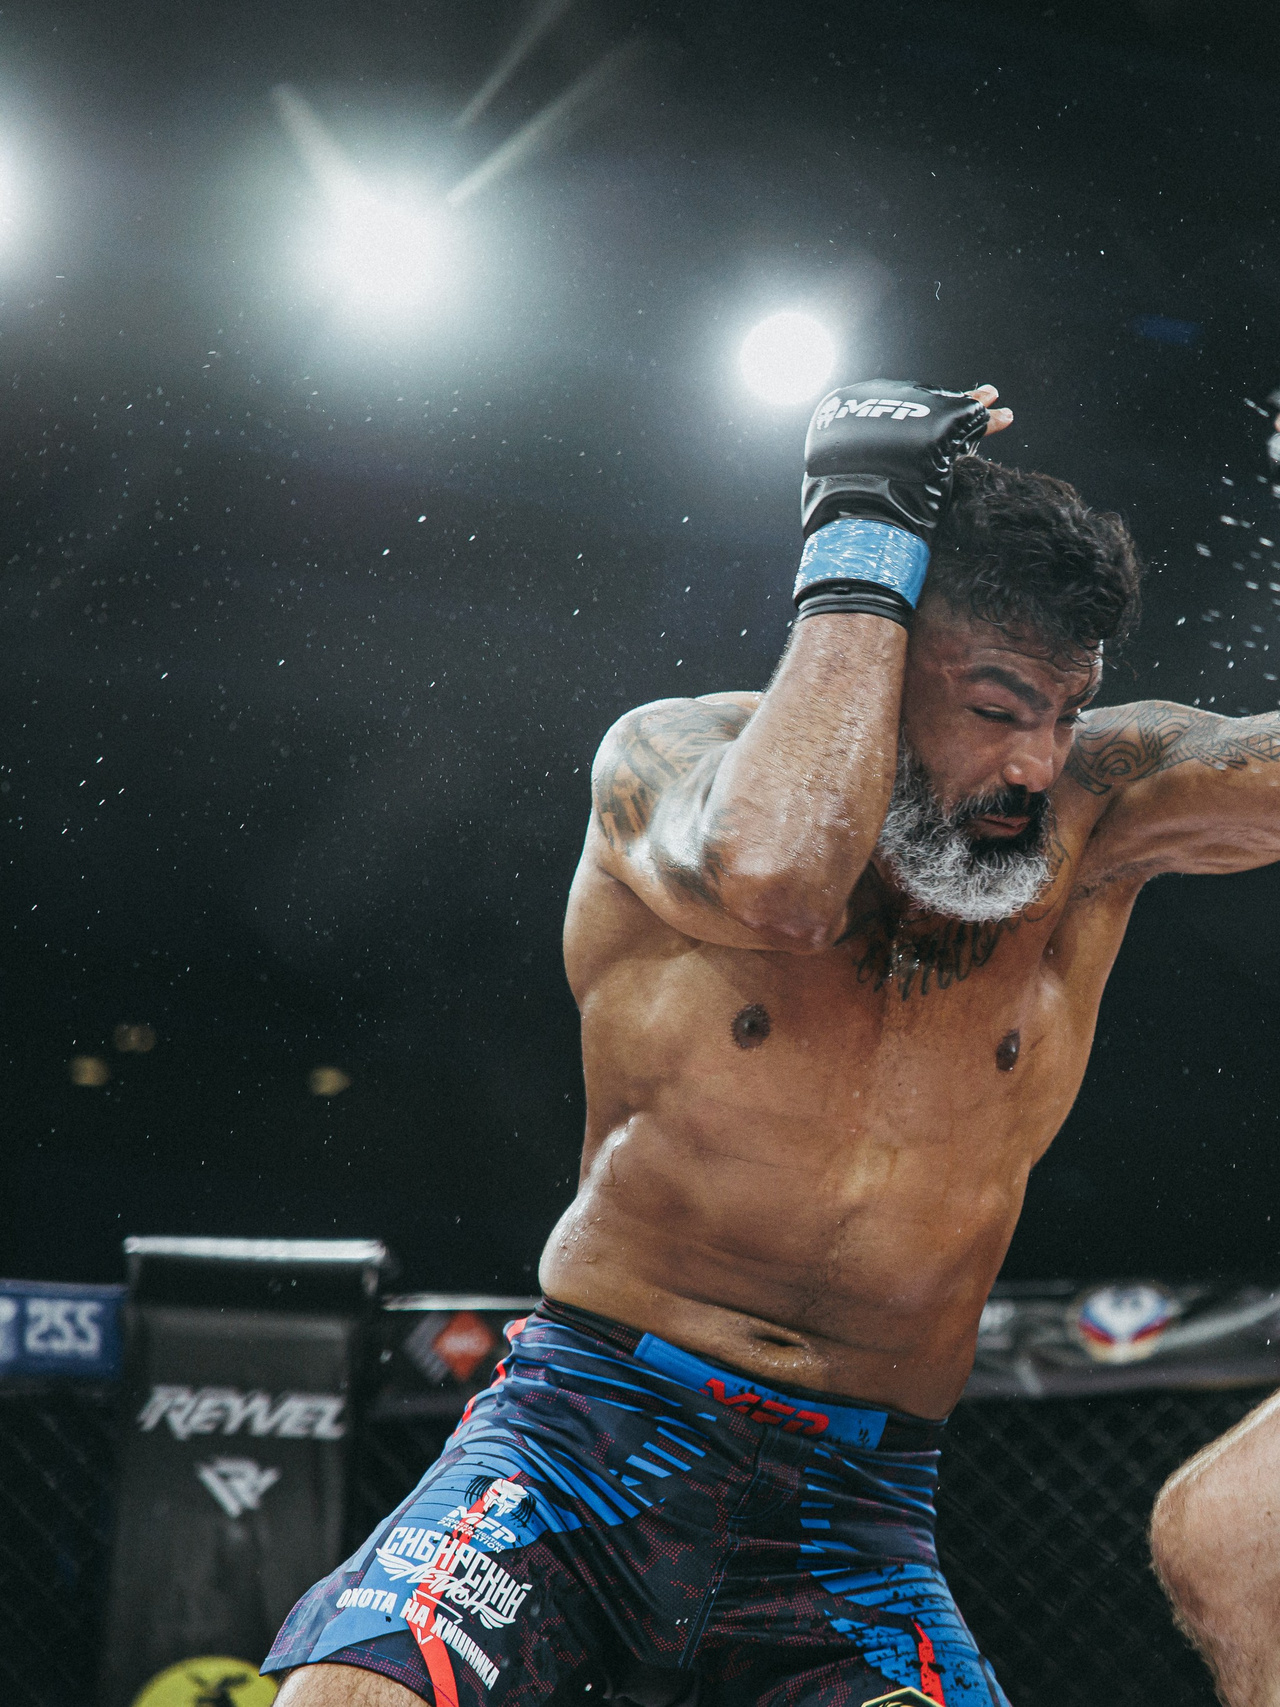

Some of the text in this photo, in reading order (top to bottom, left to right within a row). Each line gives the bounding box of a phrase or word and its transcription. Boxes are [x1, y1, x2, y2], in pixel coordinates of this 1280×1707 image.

[835, 398, 931, 420] MFP
[436, 1519, 503, 1554] PANKRATION
[447, 1505, 517, 1544] MFP
[335, 1587, 501, 1691] ОХОТА НА ХИЩНИКА
